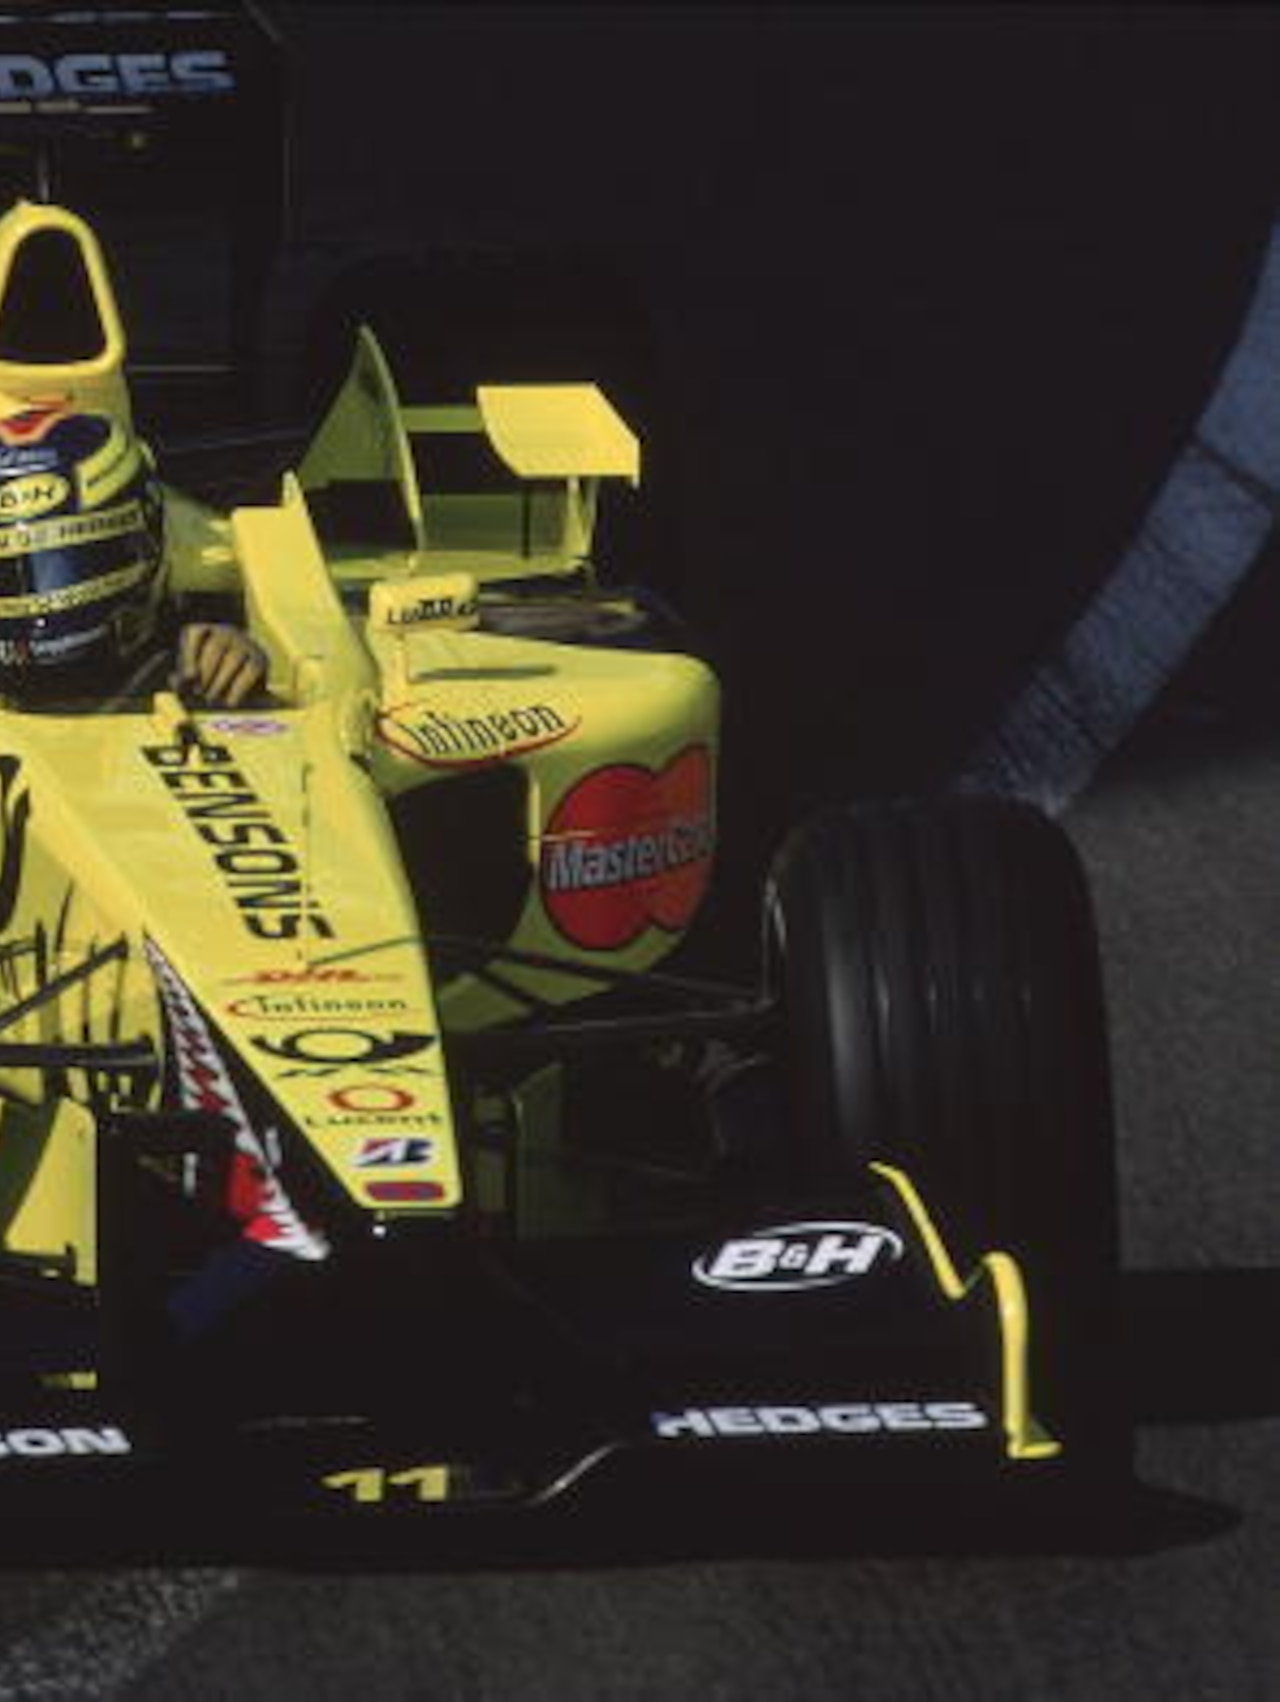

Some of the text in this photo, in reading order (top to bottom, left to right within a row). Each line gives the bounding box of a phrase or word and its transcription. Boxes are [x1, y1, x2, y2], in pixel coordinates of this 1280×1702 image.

[400, 704, 566, 757] Infineon
[709, 1235, 882, 1278] B&H
[651, 1403, 987, 1437] HEDGES
[321, 1466, 448, 1501] 11
